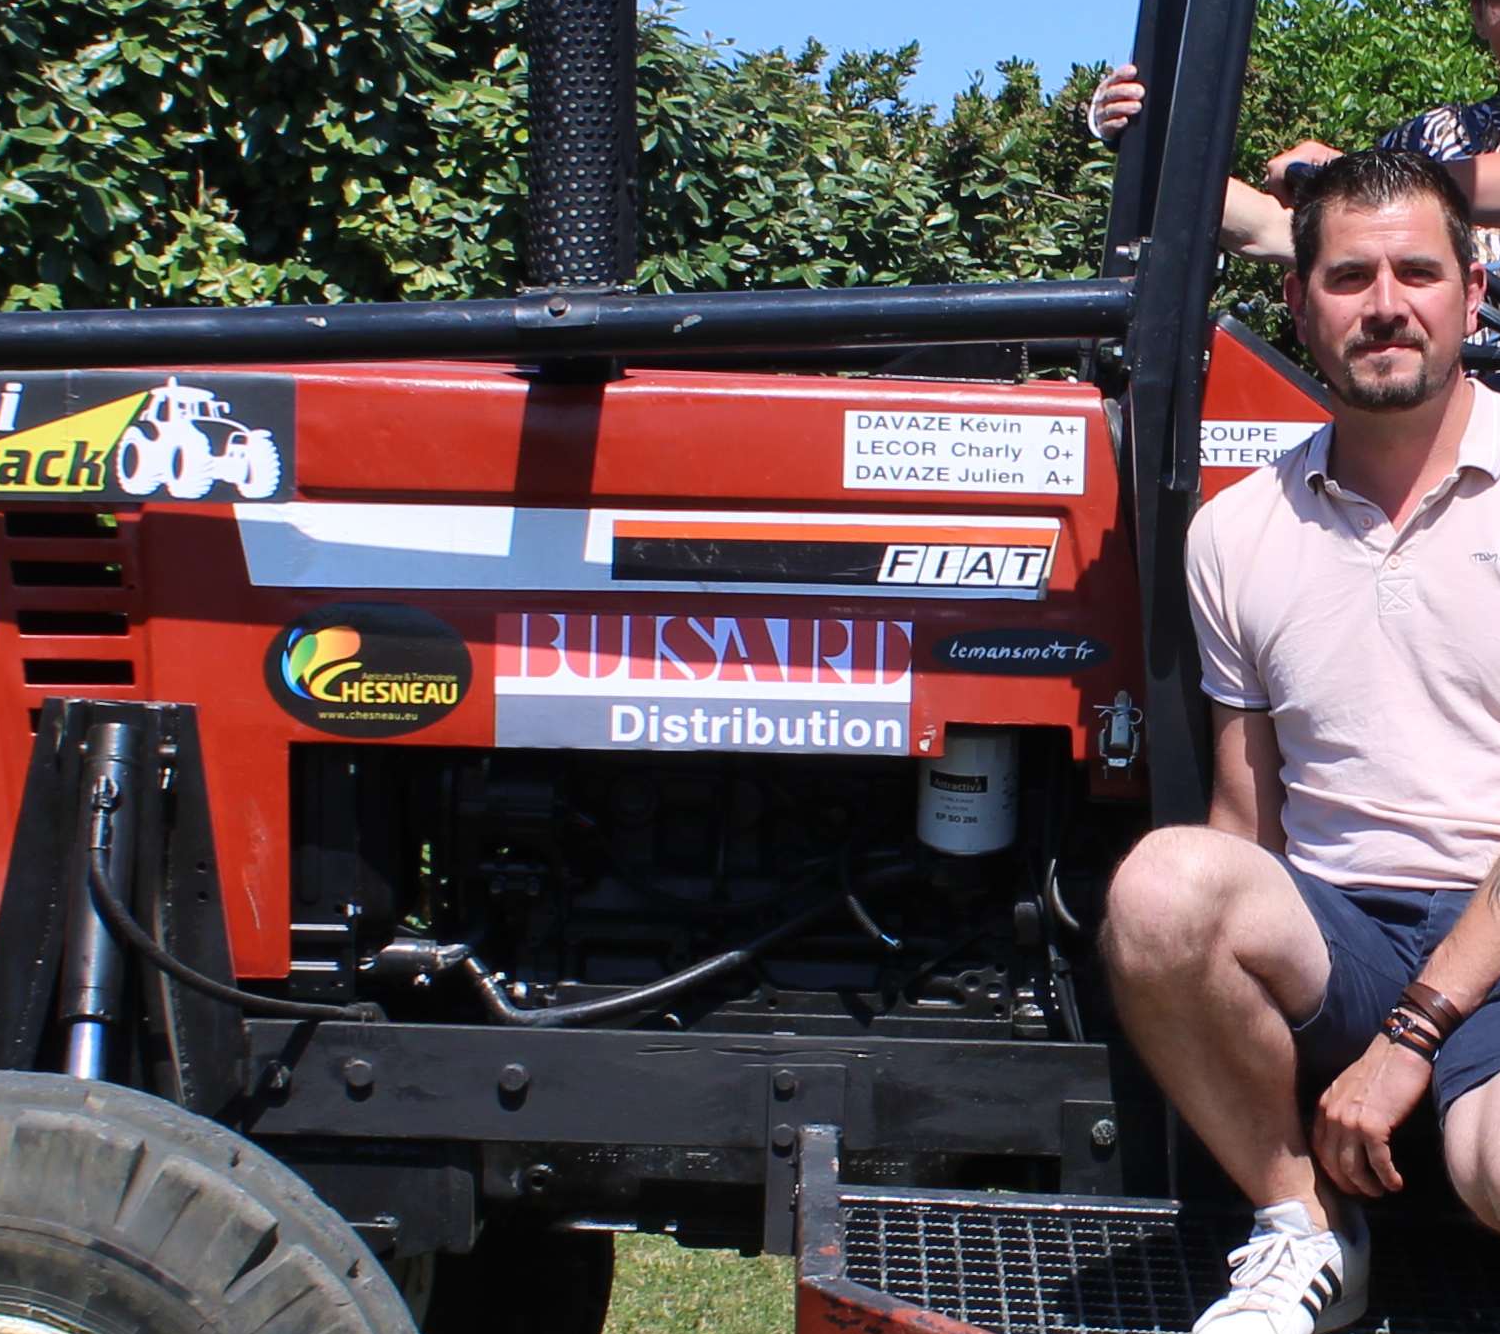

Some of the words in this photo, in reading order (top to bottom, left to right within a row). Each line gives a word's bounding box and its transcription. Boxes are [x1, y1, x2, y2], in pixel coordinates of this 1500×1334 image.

[856, 414, 952, 433] DAVAZE
[959, 417, 1023, 434] Kévin
[1049, 419, 1079, 436] A+
[855, 439, 937, 457] LECOR
[950, 441, 1023, 463] Charly
[1043, 444, 1074, 461] O+
[855, 464, 951, 482] DAVAZE
[957, 467, 1025, 485] Julien
[1044, 470, 1075, 486] A+
[886, 549, 1042, 582] FIAT
[495, 612, 913, 685] BUISARD
[309, 661, 459, 705] CHESNEAU
[361, 671, 404, 682] Agriculture
[412, 672, 458, 684] Technologie
[318, 710, 419, 721] www.chesneau.eu
[610, 703, 902, 749] Distribution
